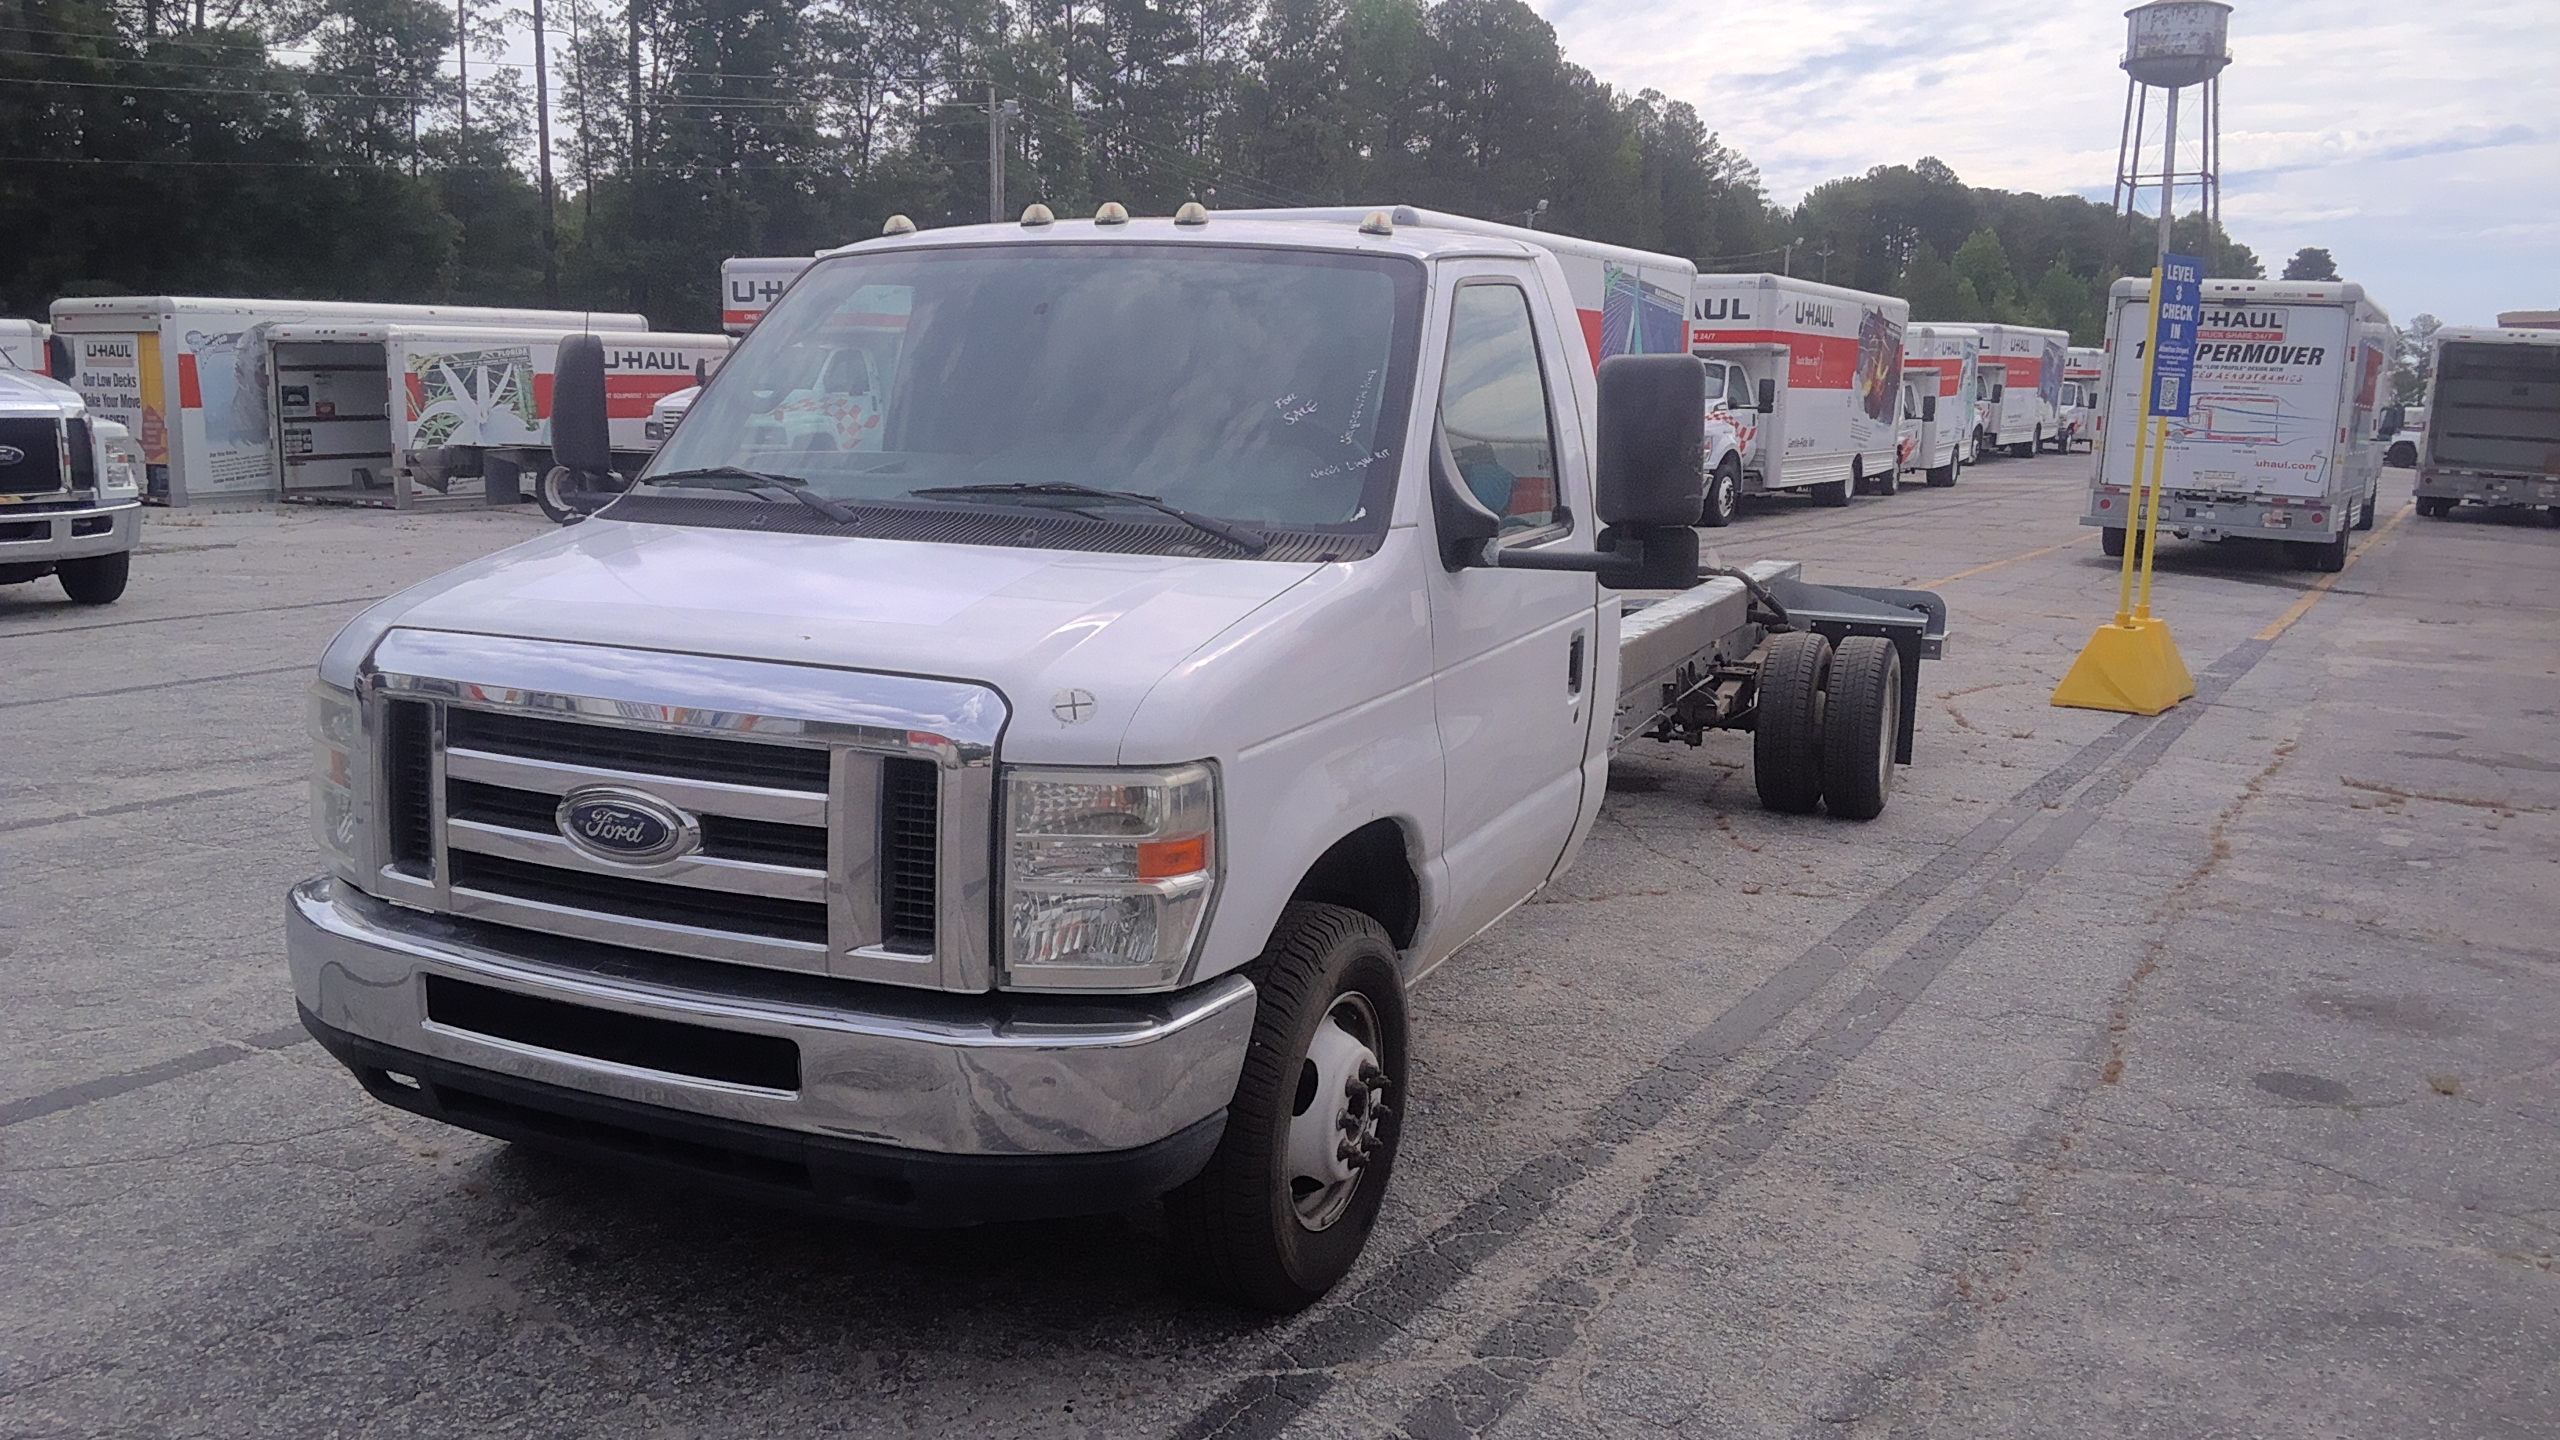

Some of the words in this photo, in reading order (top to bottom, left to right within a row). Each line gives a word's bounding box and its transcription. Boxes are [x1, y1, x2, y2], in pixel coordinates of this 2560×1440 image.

[2167, 264, 2195, 283] LEVEL
[2176, 285, 2183, 300] 3
[1796, 301, 1834, 328] U-HAUL
[2162, 303, 2193, 321] CHECK
[2170, 324, 2181, 340] IN
[86, 344, 131, 358] U-HAUL
[2195, 344, 2325, 366] PERMOVER
[83, 372, 95, 387] Our
[96, 372, 111, 387] Low
[113, 373, 137, 388] Decks
[102, 392, 118, 408] Your
[120, 393, 141, 409] Move
[2255, 460, 2317, 470] uhaul.com
[585, 808, 646, 843] Ford
